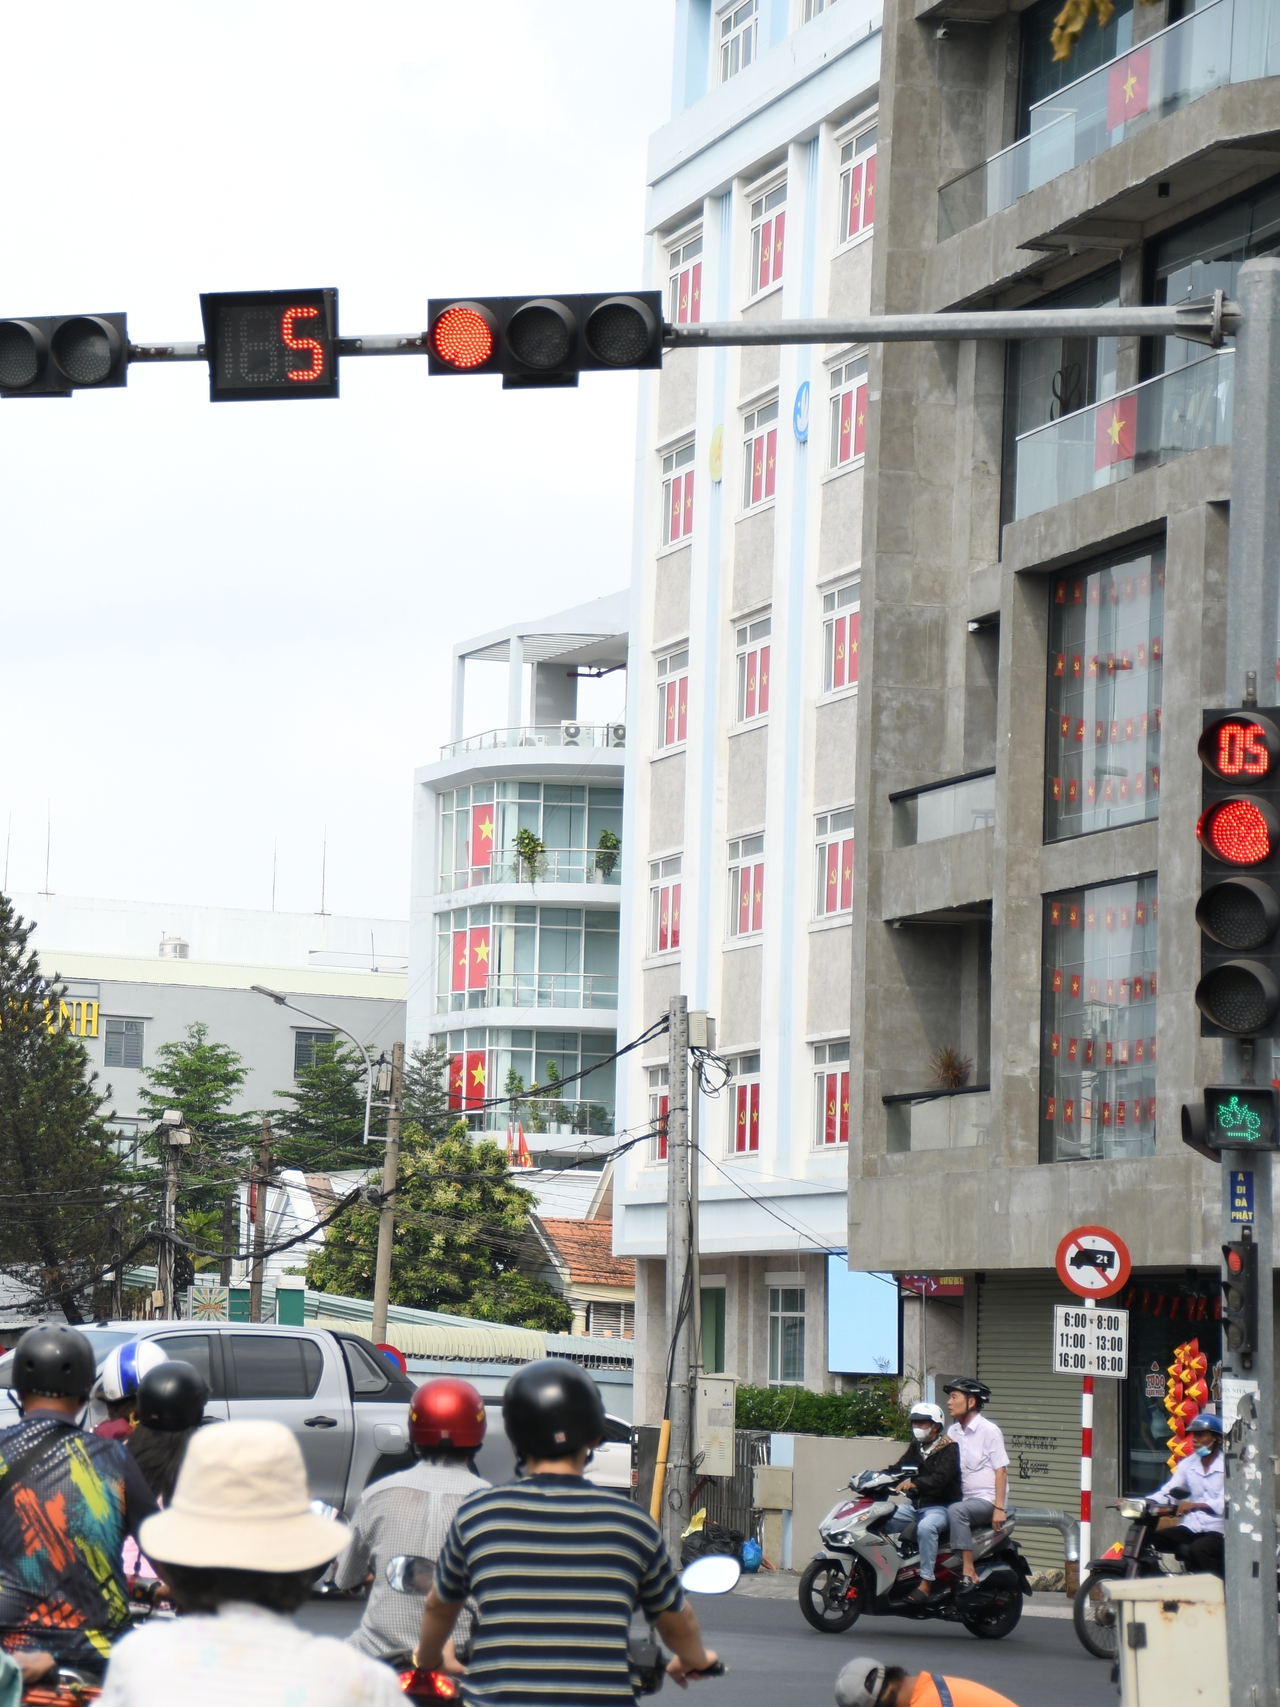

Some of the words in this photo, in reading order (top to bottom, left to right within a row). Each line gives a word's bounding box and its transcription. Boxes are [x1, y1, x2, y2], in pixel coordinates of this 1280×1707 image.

[282, 306, 324, 381] 5
[1219, 724, 1269, 775] 05
[1237, 1173, 1245, 1181] A
[1236, 1186, 1246, 1194] DI
[1231, 1210, 1253, 1221] PHẬT
[1095, 1254, 1109, 1264] 2t
[1064, 1312, 1087, 1329] 6:00
[1096, 1315, 1120, 1331] 8:00
[1059, 1333, 1086, 1349] 11:00
[1095, 1335, 1123, 1352] 13:00
[1058, 1353, 1086, 1369] 16:00
[1096, 1356, 1123, 1372] 18:00
